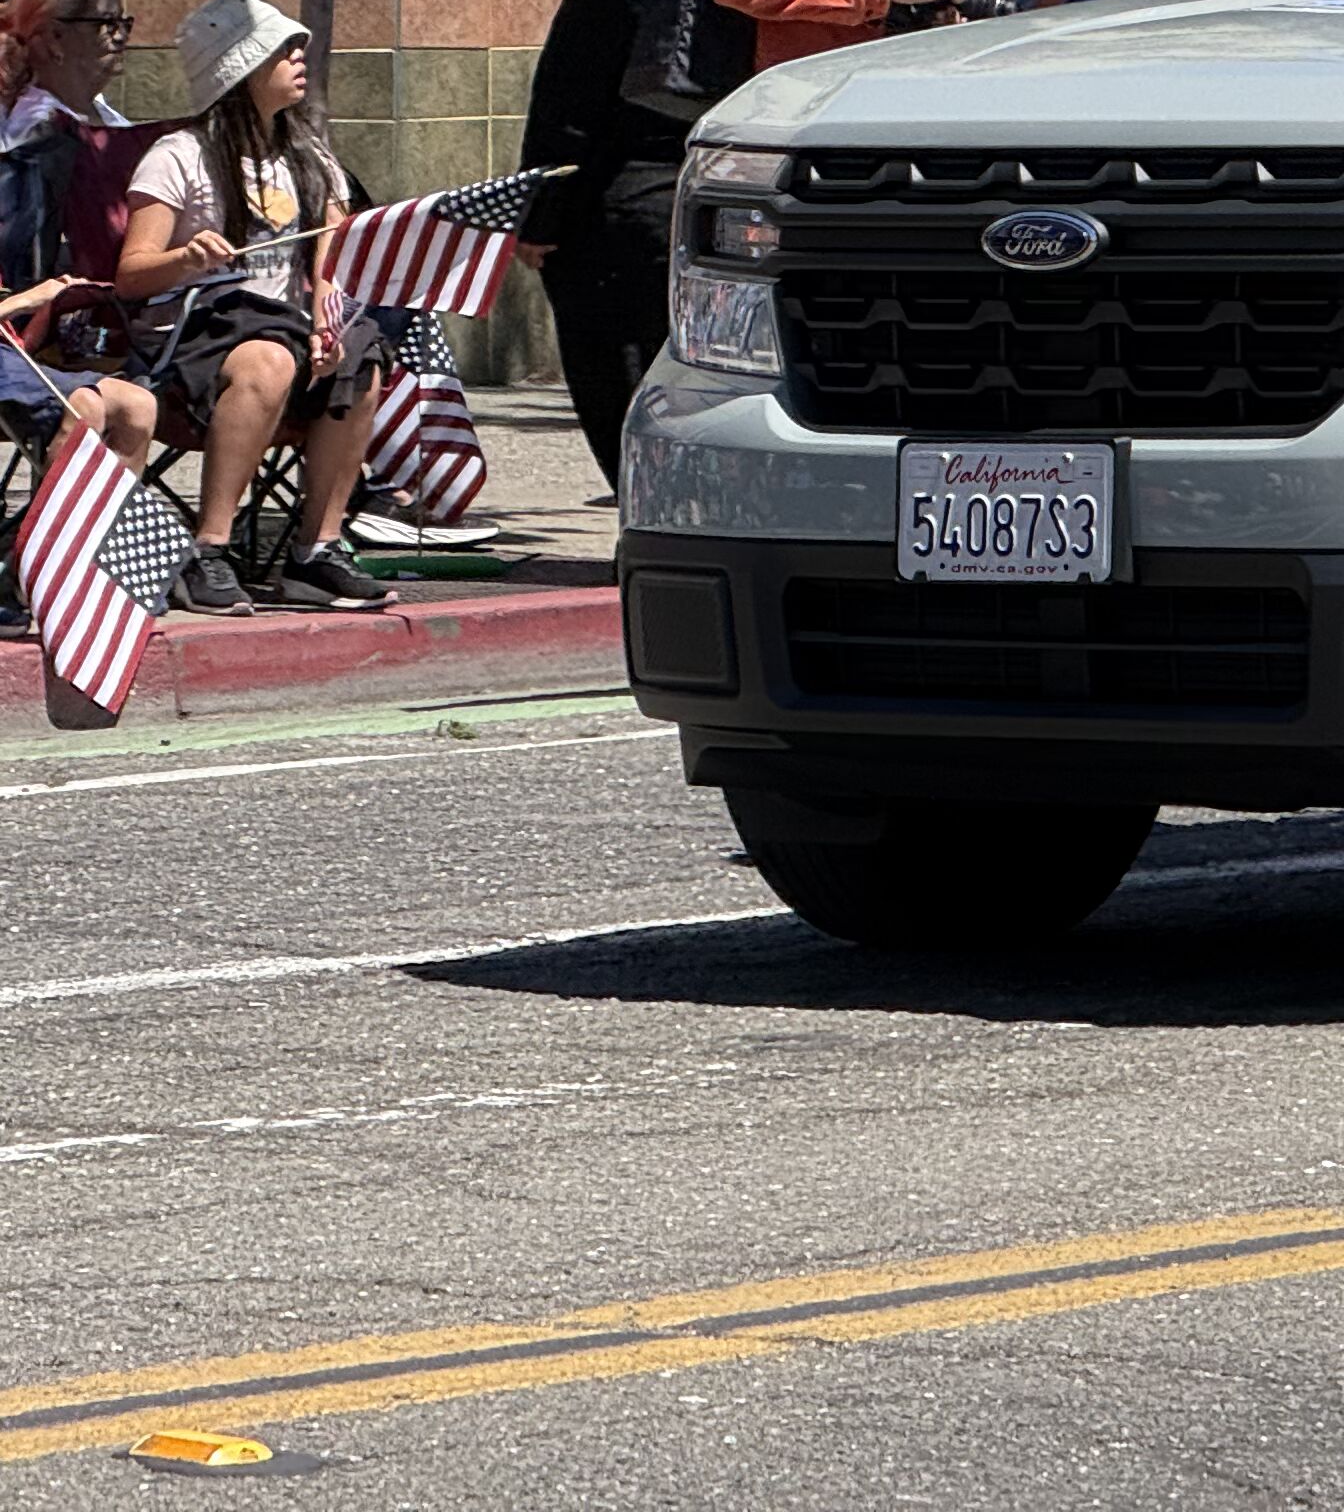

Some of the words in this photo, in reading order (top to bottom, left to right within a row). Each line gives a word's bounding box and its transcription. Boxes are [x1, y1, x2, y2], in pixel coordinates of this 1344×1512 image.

[1004, 223, 1068, 256] Ford
[944, 453, 1075, 494] California
[912, 492, 1098, 559] 54087S3
[950, 563, 1059, 576] dmv.ca.gov
